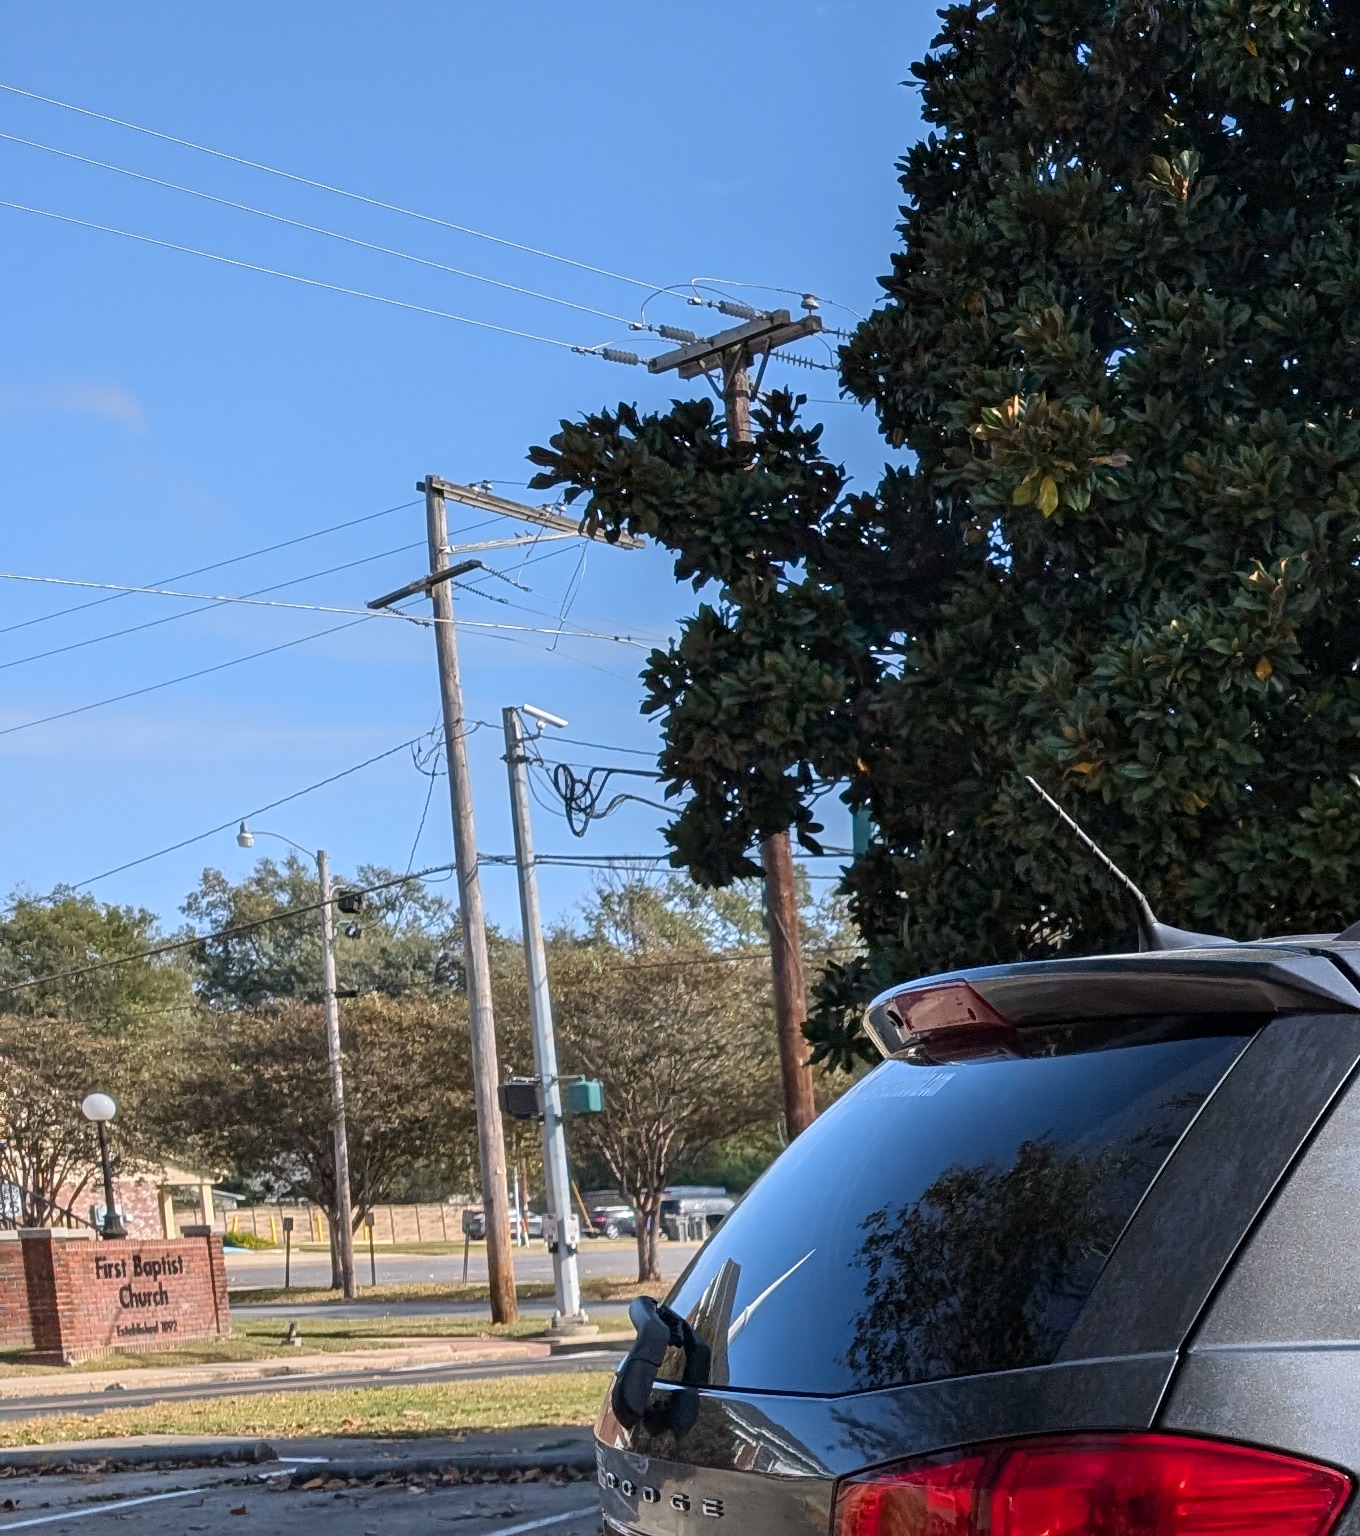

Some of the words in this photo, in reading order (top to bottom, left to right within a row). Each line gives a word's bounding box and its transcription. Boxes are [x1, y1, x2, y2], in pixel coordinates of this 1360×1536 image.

[94, 1256, 127, 1280] First
[132, 1252, 184, 1282] Baptist
[118, 1281, 170, 1309] Church
[605, 1472, 724, 1518] DODGE
